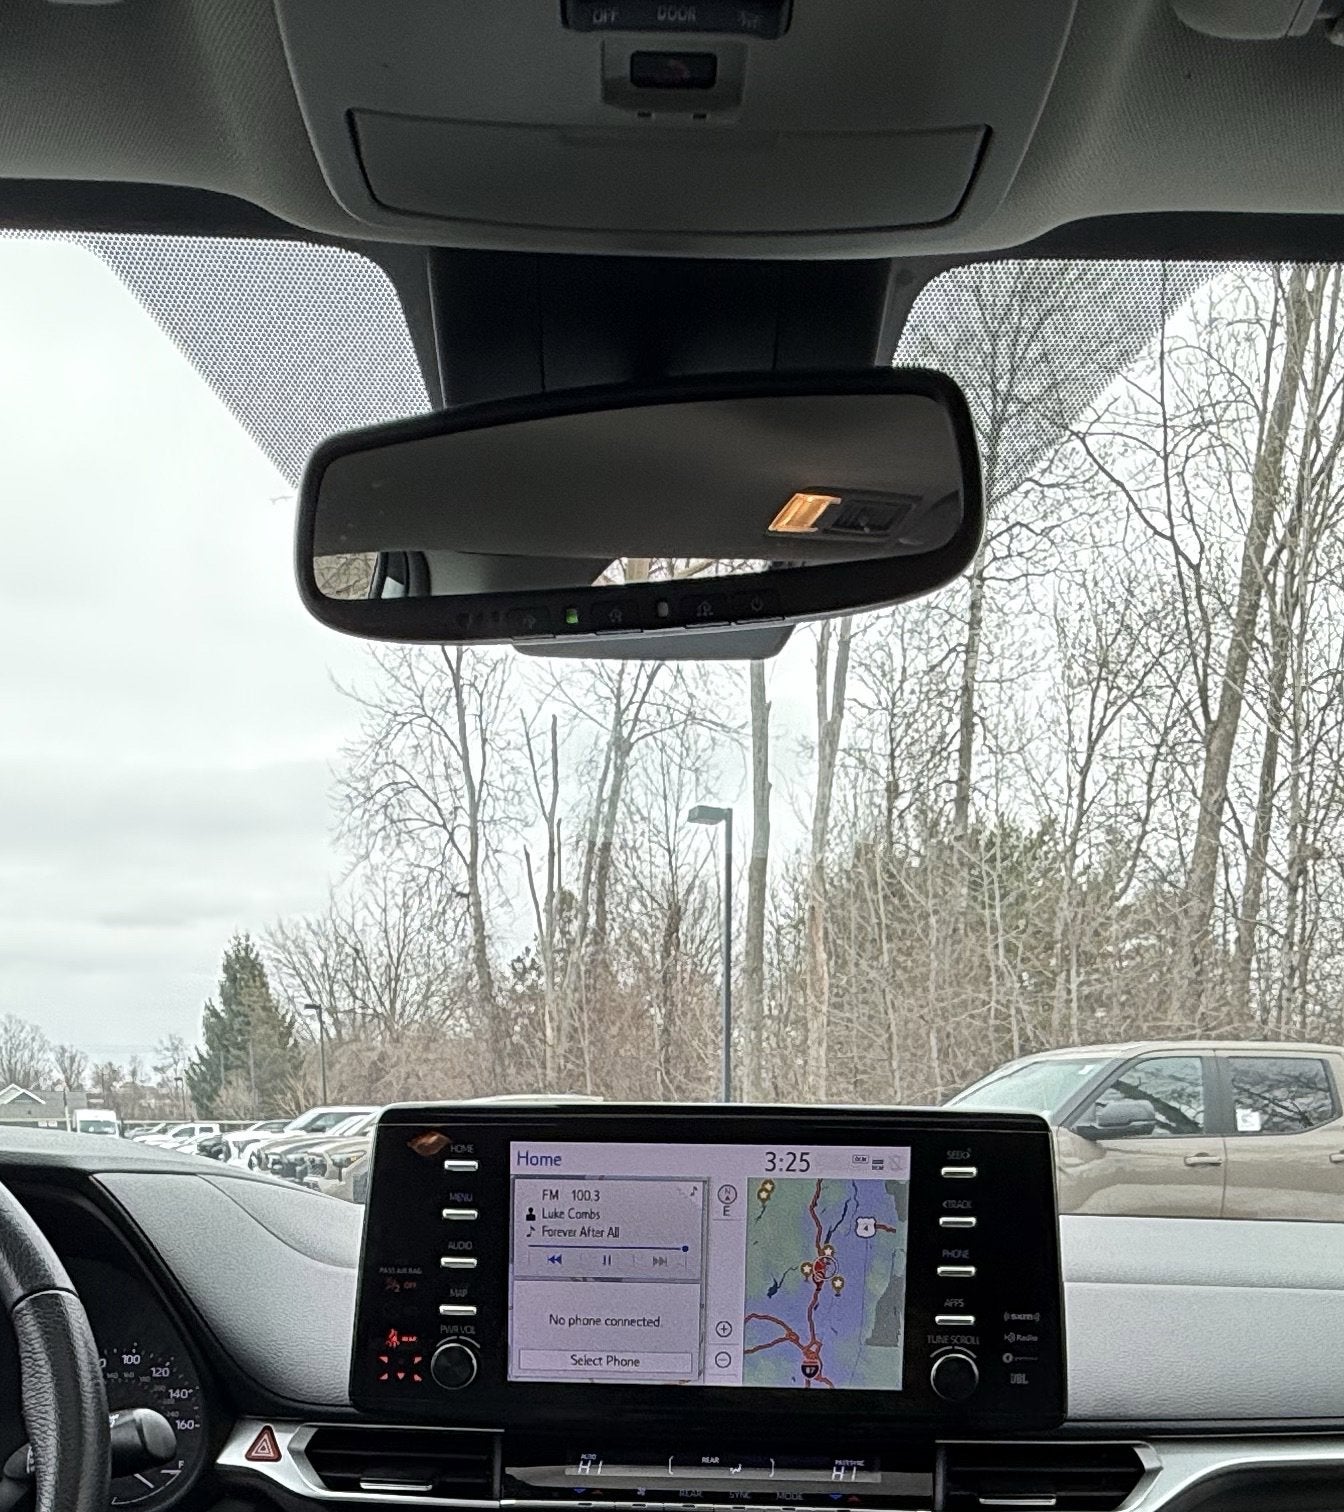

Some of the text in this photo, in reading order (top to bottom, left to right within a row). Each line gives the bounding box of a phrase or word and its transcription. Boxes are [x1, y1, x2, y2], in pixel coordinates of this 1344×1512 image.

[656, 6, 697, 21] DOOR
[516, 1150, 562, 1166] Home
[764, 1151, 811, 1173] 3:25
[542, 1189, 601, 1202] FM 100.3
[542, 1207, 601, 1220] Luke Combs
[541, 1226, 620, 1239] Forever After All
[447, 1241, 473, 1250] AUDIO
[549, 1313, 566, 1326] No
[568, 1314, 602, 1329] phone
[121, 1354, 141, 1365] 100
[570, 1354, 640, 1368] Select Phone
[150, 1367, 170, 1377] 120
[168, 1389, 189, 1399] 140
[175, 1420, 195, 1430] 160
